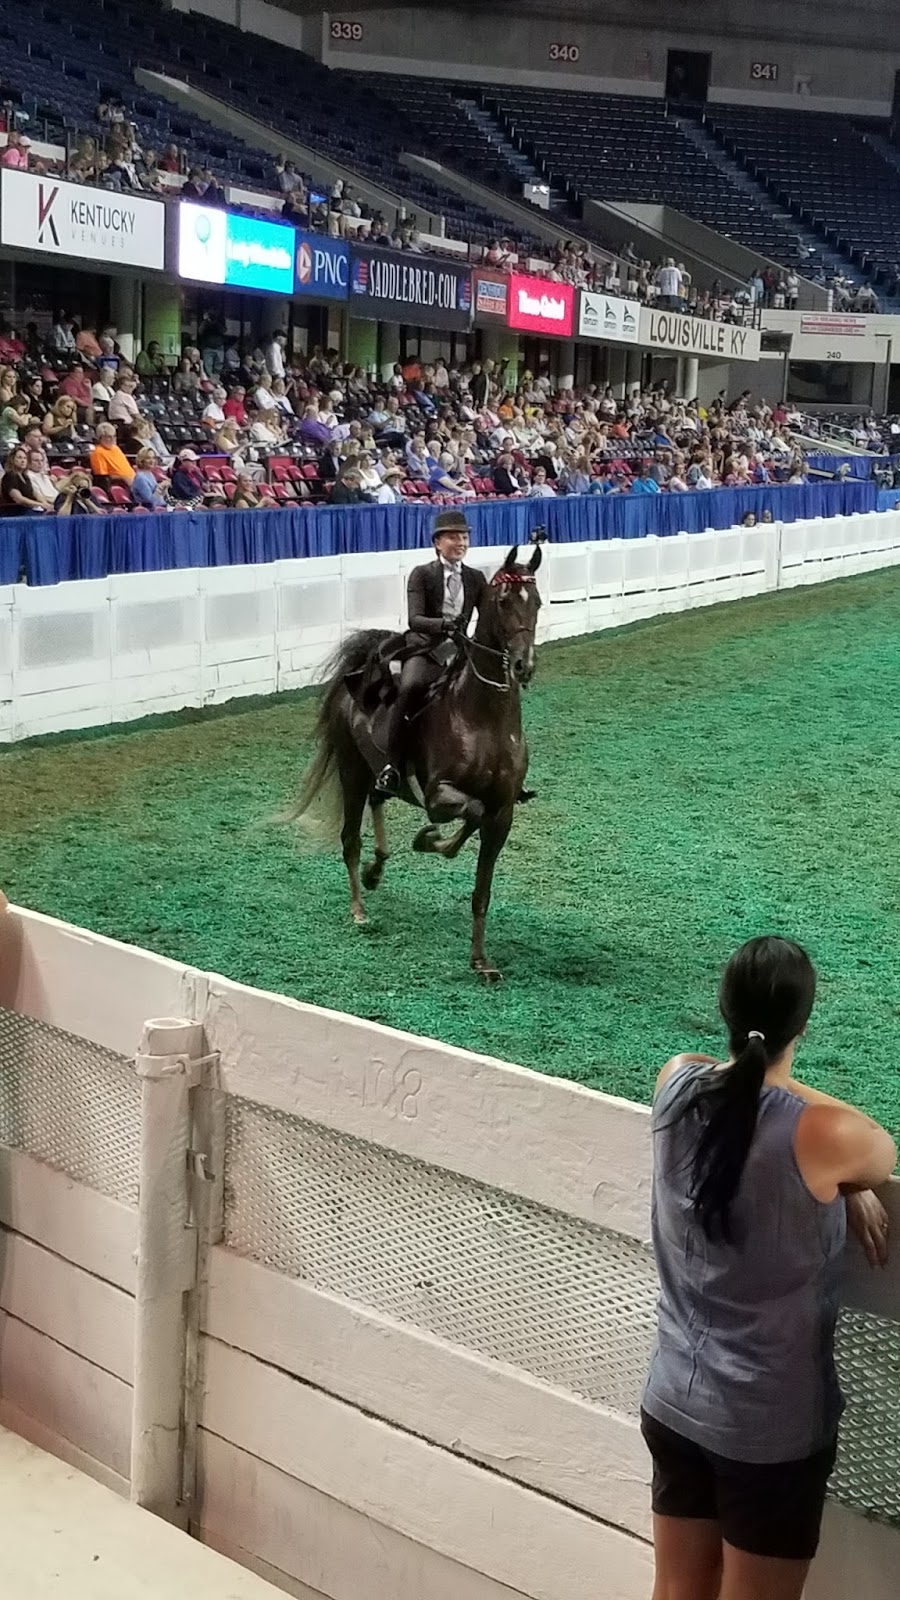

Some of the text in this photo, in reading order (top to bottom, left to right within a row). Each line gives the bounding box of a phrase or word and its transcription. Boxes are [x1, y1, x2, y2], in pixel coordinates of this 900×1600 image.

[331, 22, 362, 41] 339
[549, 44, 579, 62] 340
[752, 63, 778, 80] 341
[71, 200, 136, 235] KENTUCKY
[71, 230, 126, 248] VENUES
[314, 249, 348, 287] PNC
[650, 313, 748, 356] LOUISVILLE KY
[826, 351, 842, 359] 240
